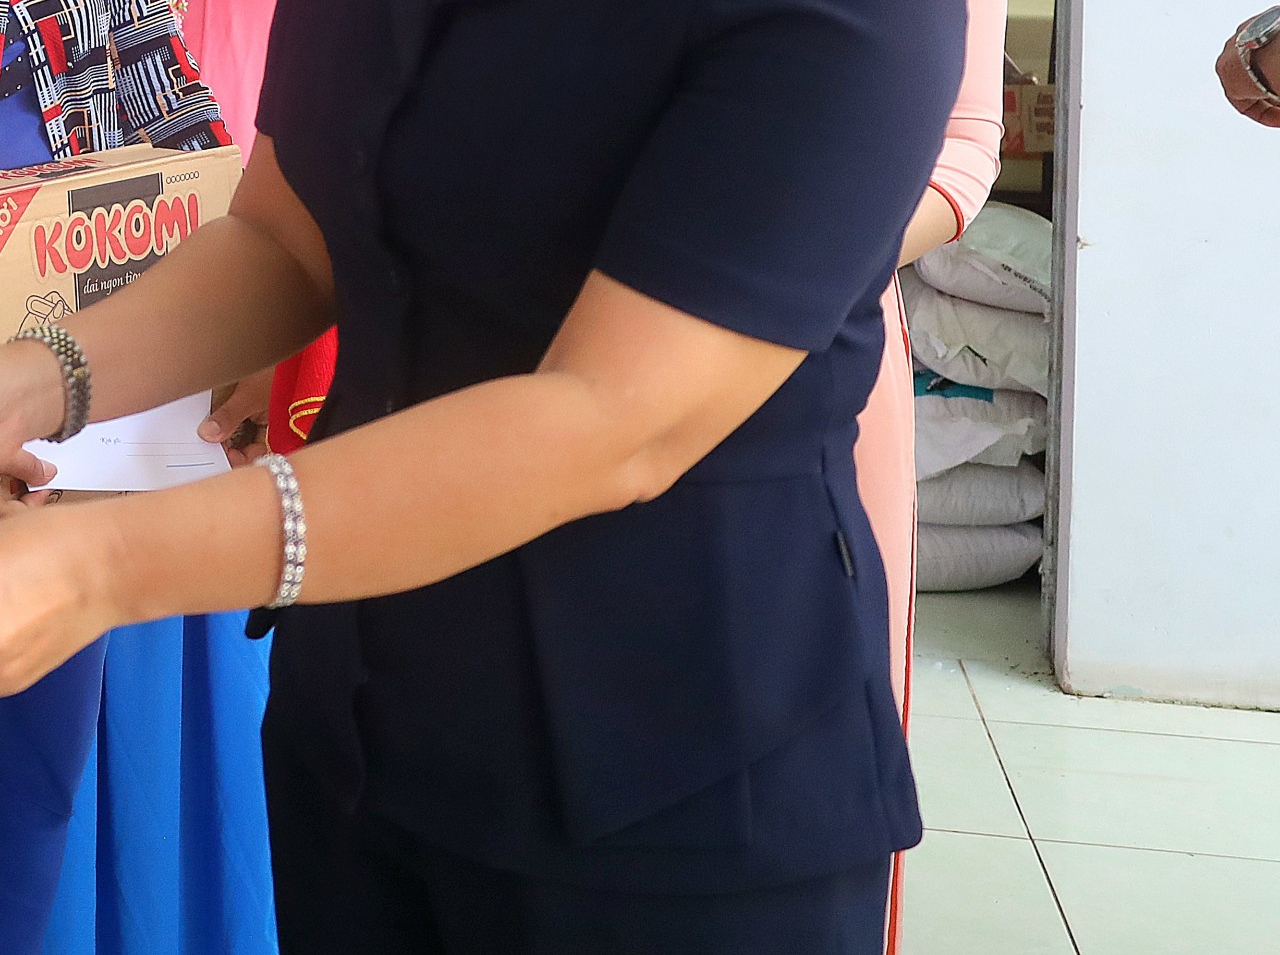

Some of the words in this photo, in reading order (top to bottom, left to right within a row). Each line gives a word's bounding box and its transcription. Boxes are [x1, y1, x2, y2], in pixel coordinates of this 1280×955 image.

[33, 191, 201, 279] KOKOMI
[83, 278, 99, 294] dai
[100, 277, 124, 296] ngon
